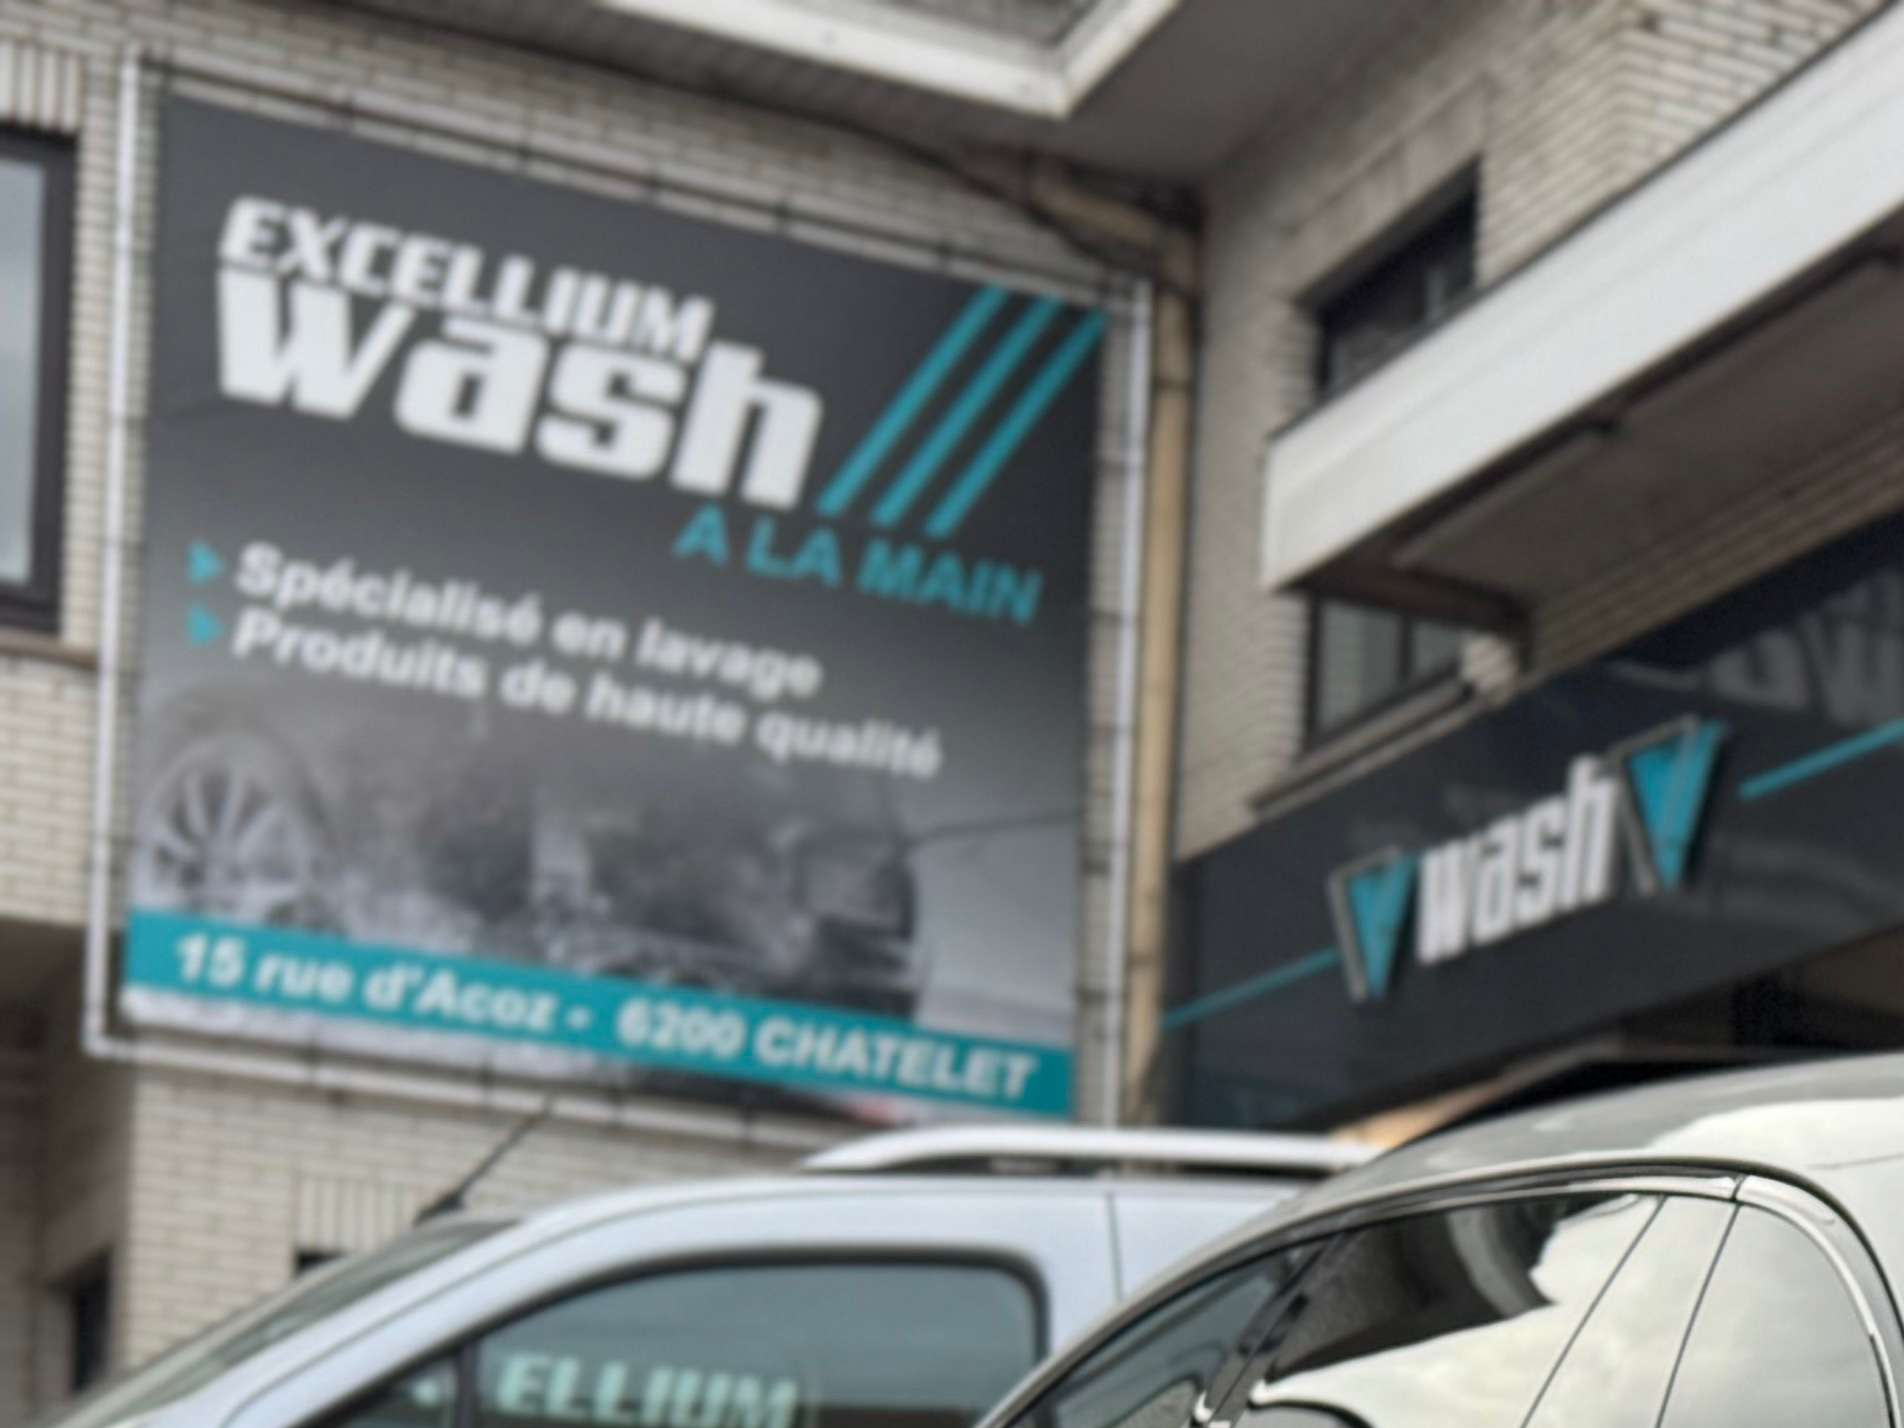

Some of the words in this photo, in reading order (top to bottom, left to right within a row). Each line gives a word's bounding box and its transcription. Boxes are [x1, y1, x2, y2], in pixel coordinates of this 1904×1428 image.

[217, 195, 713, 364] EXCELLIUM
[235, 540, 543, 646] Spécialisé
[551, 611, 627, 660] en
[636, 616, 824, 702] lavage
[674, 502, 729, 568] A
[744, 516, 843, 590] LA
[857, 536, 1044, 627] MAIN
[233, 607, 486, 699] Produits
[500, 661, 575, 717] de
[584, 670, 747, 745] haute
[754, 709, 945, 780] qualité
[177, 933, 246, 990] 15
[254, 953, 354, 1002] rue
[362, 961, 559, 1031] d'Acoz
[616, 999, 745, 1059] 6200
[754, 1017, 1037, 1098] CHATELET
